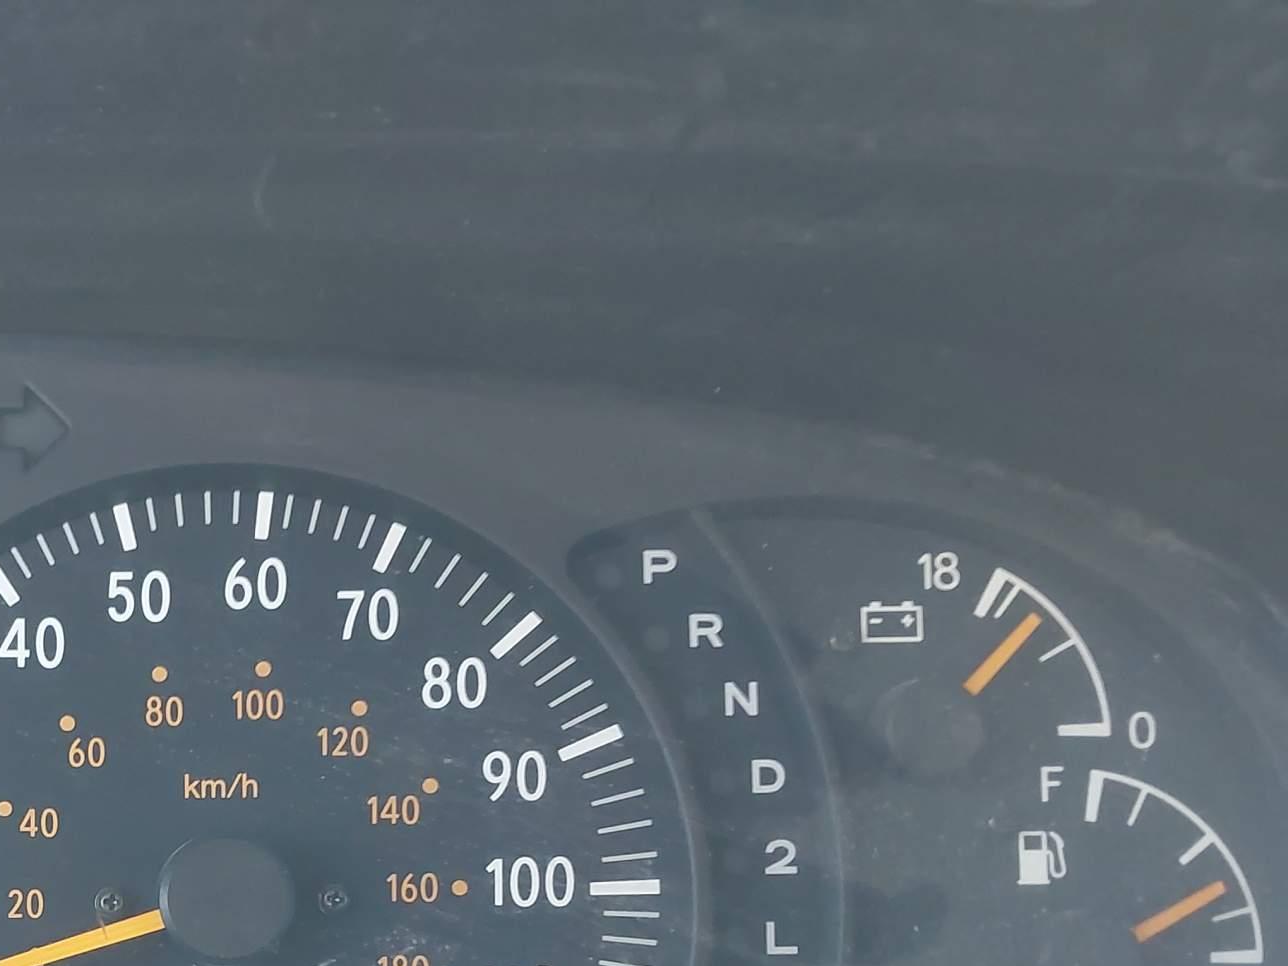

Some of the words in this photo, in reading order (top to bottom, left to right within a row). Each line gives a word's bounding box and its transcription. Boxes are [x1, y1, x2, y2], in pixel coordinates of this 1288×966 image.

[225, 558, 286, 609] 60
[643, 550, 676, 584] P
[918, 552, 960, 590] 18
[108, 571, 170, 622] 50
[337, 589, 398, 640] 70
[689, 614, 723, 647] R
[0, 617, 64, 668] 40
[422, 657, 486, 708] 80
[725, 682, 758, 716] N
[146, 696, 182, 726] 80
[233, 690, 283, 719] 100
[318, 727, 368, 756] 120
[1129, 712, 1155, 749] 0
[69, 738, 104, 767] 60
[185, 773, 257, 798] km/h
[483, 751, 546, 801] 90
[752, 760, 785, 793] D
[1041, 766, 1064, 802] F
[20, 809, 57, 837] 40
[368, 796, 419, 824] 140
[765, 840, 797, 874] 2
[387, 873, 438, 902] 160
[486, 856, 574, 907] 100
[8, 889, 43, 918] 20
[766, 922, 798, 954] L
